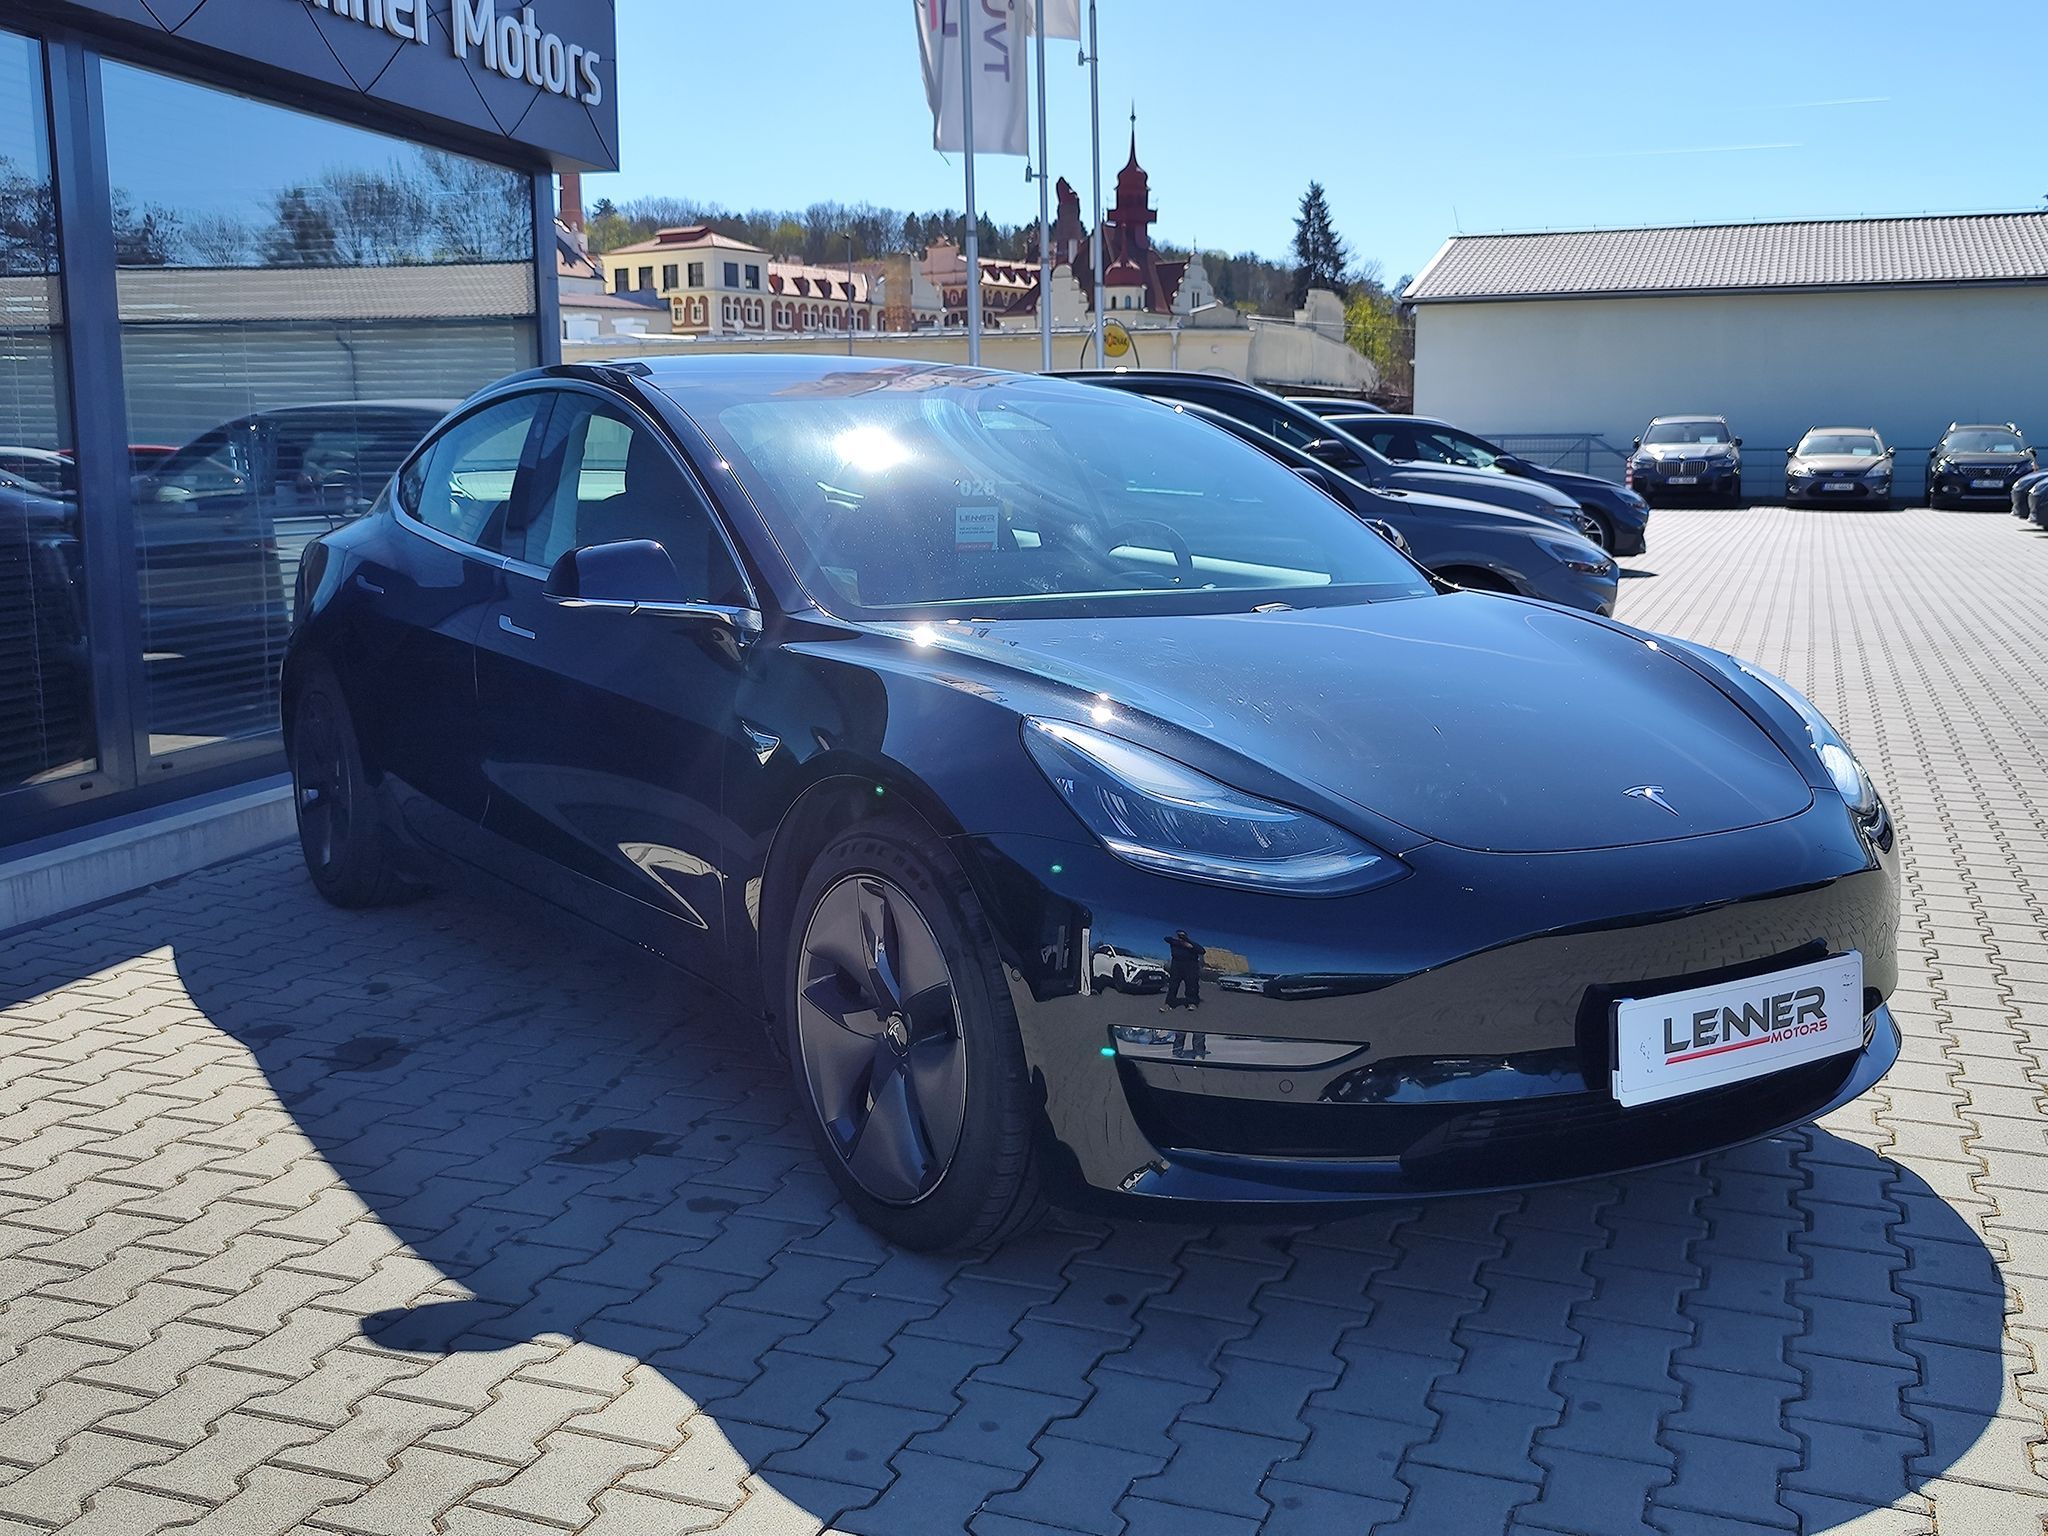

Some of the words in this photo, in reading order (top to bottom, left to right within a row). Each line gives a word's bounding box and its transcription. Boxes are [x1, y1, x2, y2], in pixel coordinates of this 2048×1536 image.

[451, 0, 602, 106] Motors
[1664, 986, 1827, 1054] LENNER
[1770, 1019, 1828, 1044] MOTORS
